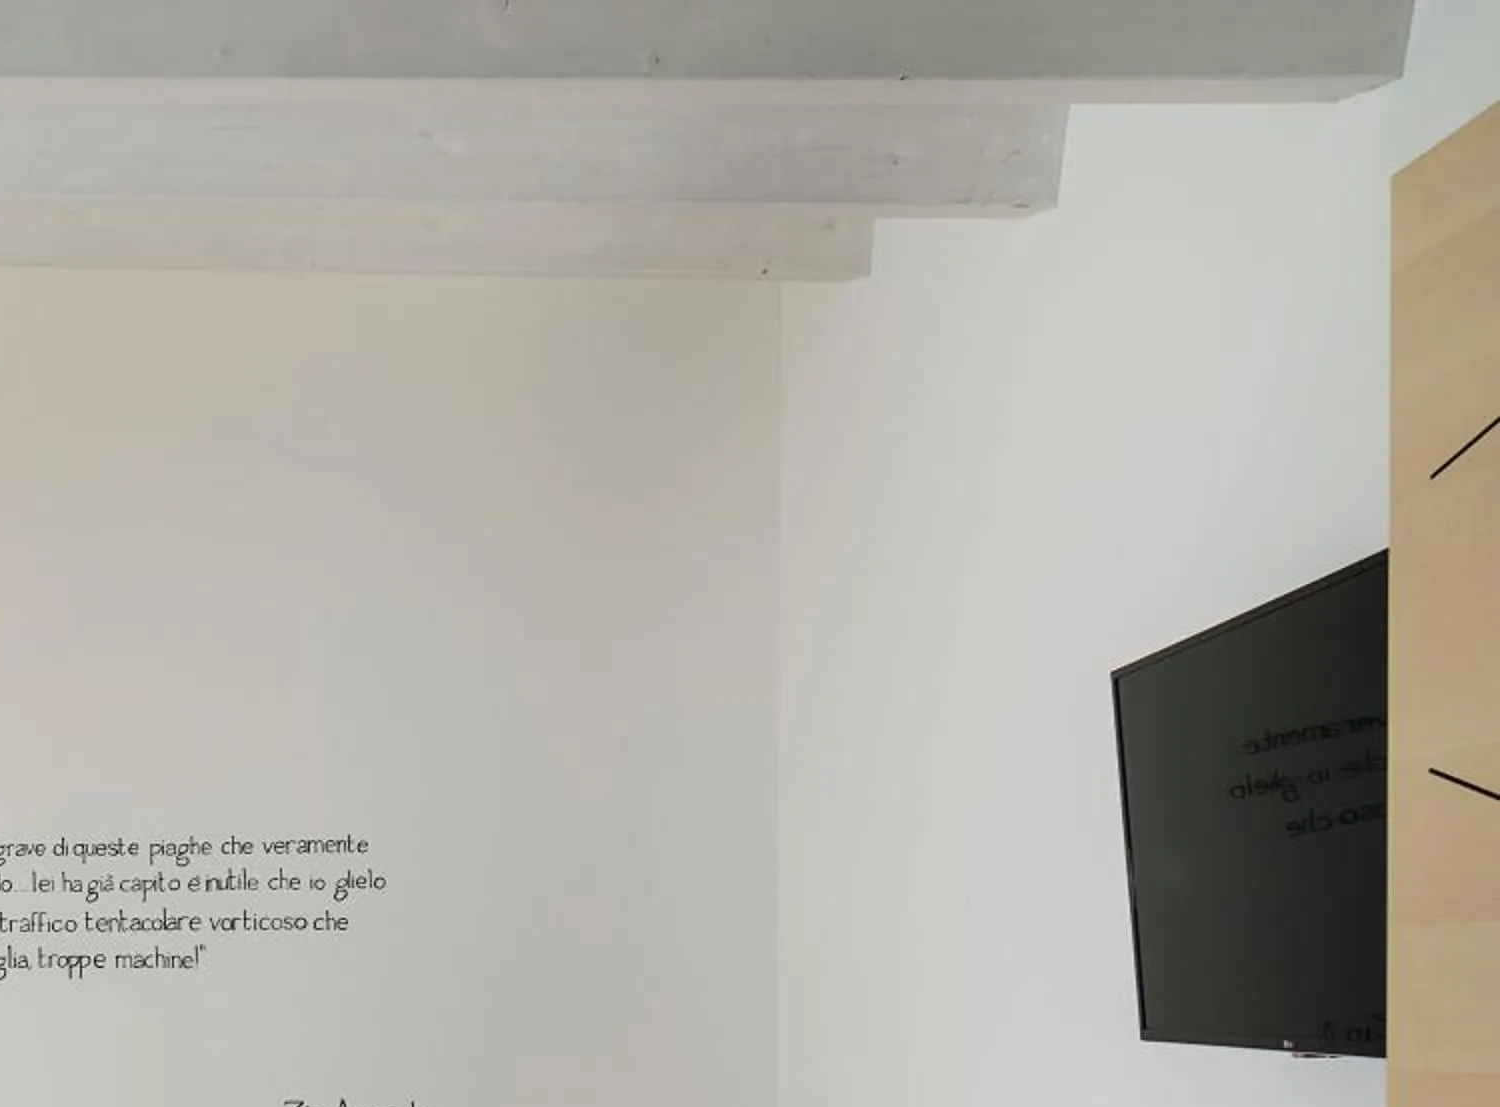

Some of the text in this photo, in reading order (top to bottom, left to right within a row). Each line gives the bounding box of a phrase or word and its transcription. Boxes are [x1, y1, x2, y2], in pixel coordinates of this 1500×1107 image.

[52, 837, 69, 857] di
[72, 837, 139, 865] queste
[148, 835, 212, 867] piaghe
[221, 835, 254, 855] che
[261, 833, 369, 855] veramente
[61, 870, 83, 893] ha
[119, 871, 181, 903] capito
[205, 867, 259, 892] inutile
[267, 867, 301, 891] che
[309, 873, 327, 891] io
[333, 868, 387, 902] glielo
[84, 907, 201, 933] tentacolare
[208, 908, 308, 931] vorticoso
[313, 909, 349, 931] che
[37, 946, 107, 980] troppe
